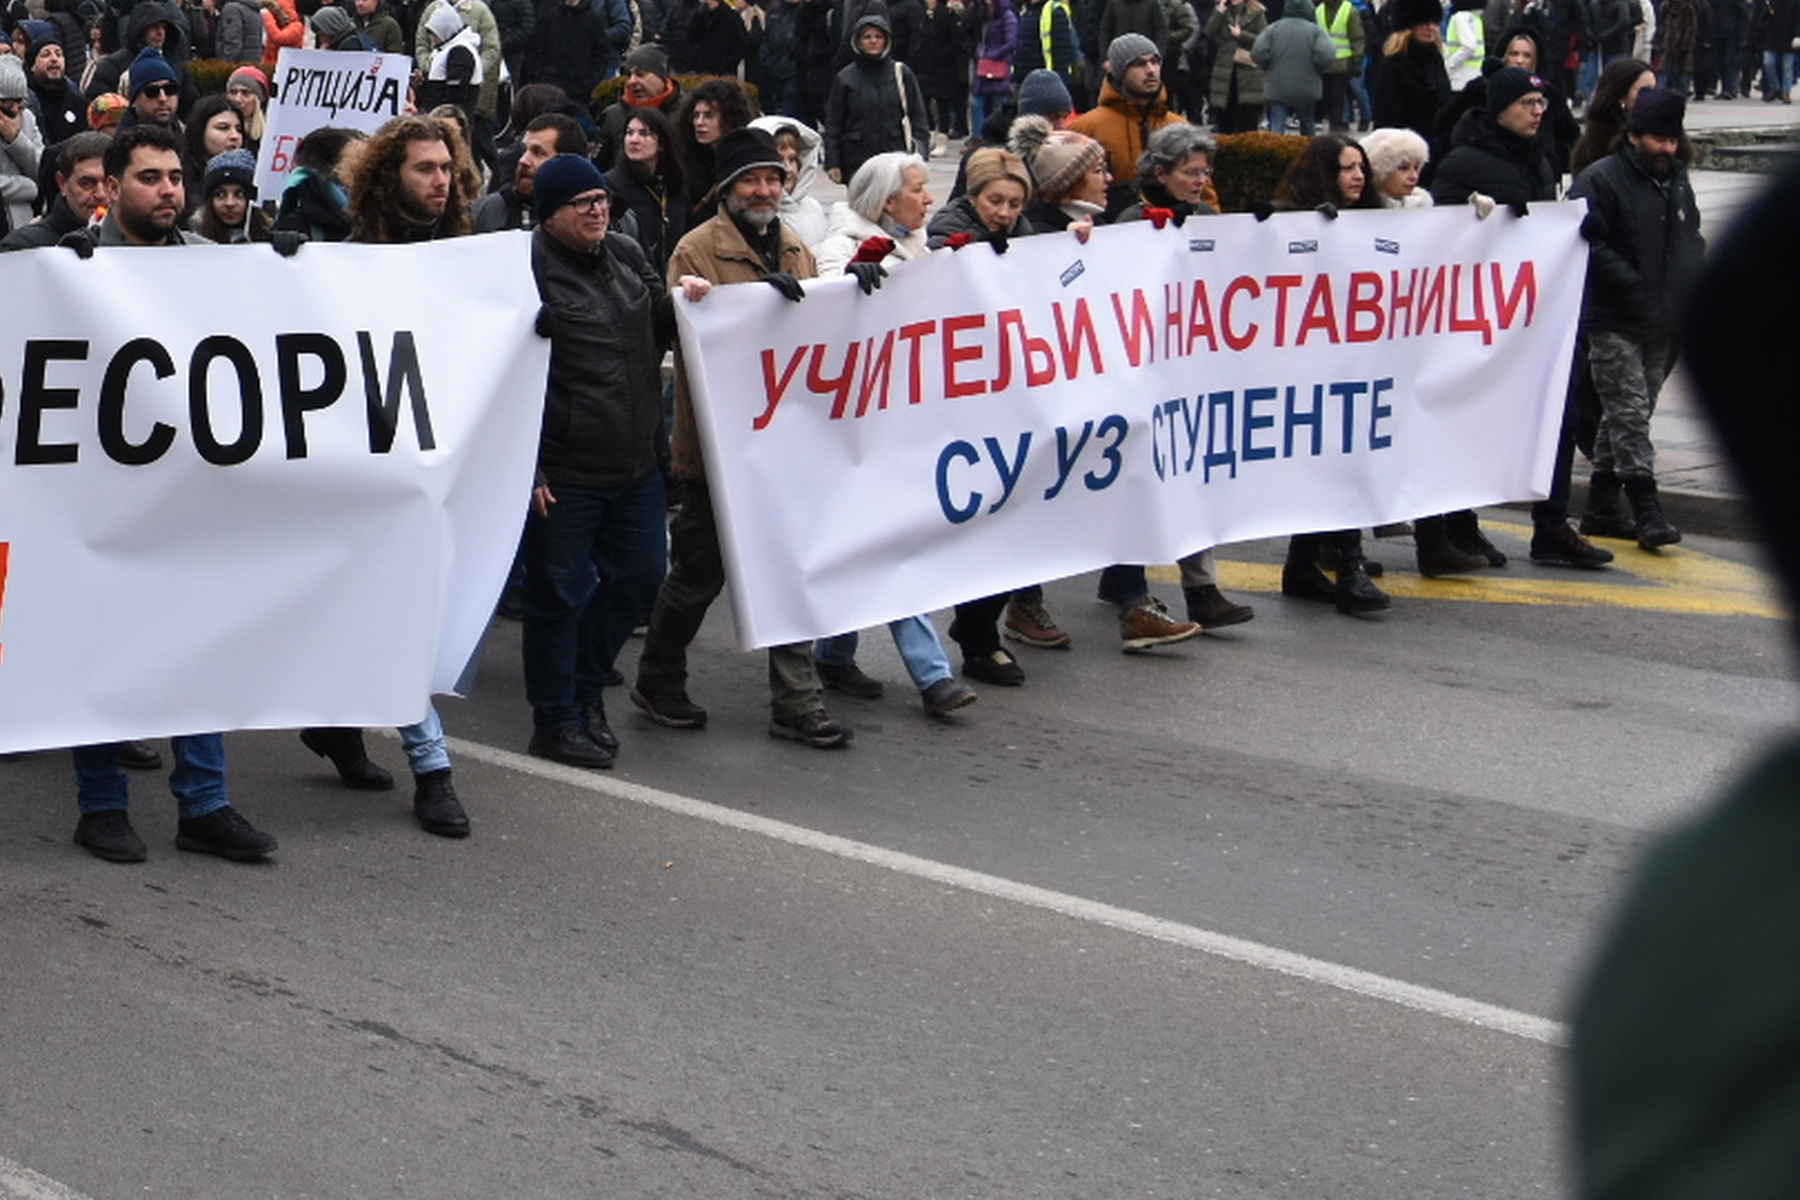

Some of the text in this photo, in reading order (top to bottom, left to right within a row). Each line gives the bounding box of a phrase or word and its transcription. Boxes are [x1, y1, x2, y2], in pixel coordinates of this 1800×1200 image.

[753, 259, 1538, 431] УЧИТЕЉИ И НАСТАВНИЦИ
[934, 377, 1395, 525] СУ УЗ СТУДЕНТЕ
